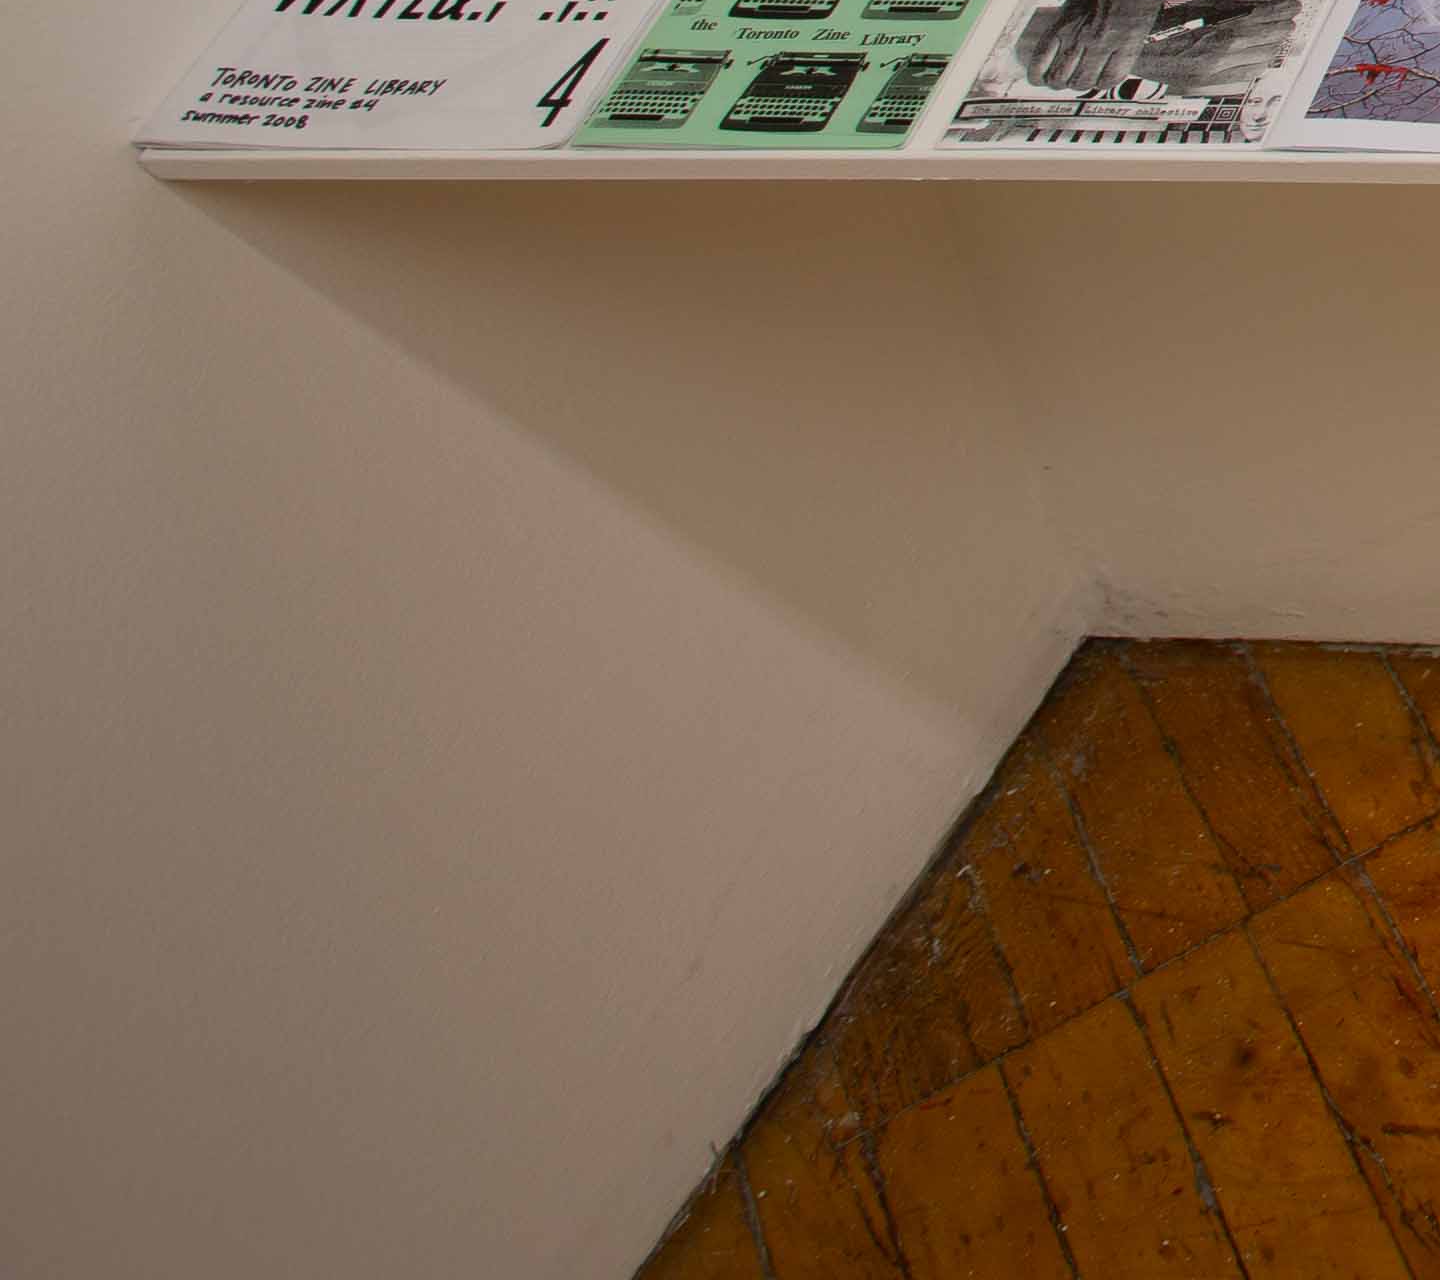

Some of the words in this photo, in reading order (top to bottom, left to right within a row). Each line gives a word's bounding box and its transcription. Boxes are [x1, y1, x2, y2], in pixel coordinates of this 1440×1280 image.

[690, 18, 719, 32] the
[736, 27, 801, 41] Toronto
[811, 27, 851, 41] Zine
[861, 31, 927, 47] Library
[303, 75, 358, 95] ZINE
[363, 77, 448, 97] LIBRARY
[537, 38, 611, 127] 4
[199, 91, 214, 103] a
[218, 92, 301, 109] resource
[302, 94, 347, 111] zine
[1083, 105, 1132, 118] Library
[180, 110, 261, 127] summer
[261, 113, 310, 130] 2008
